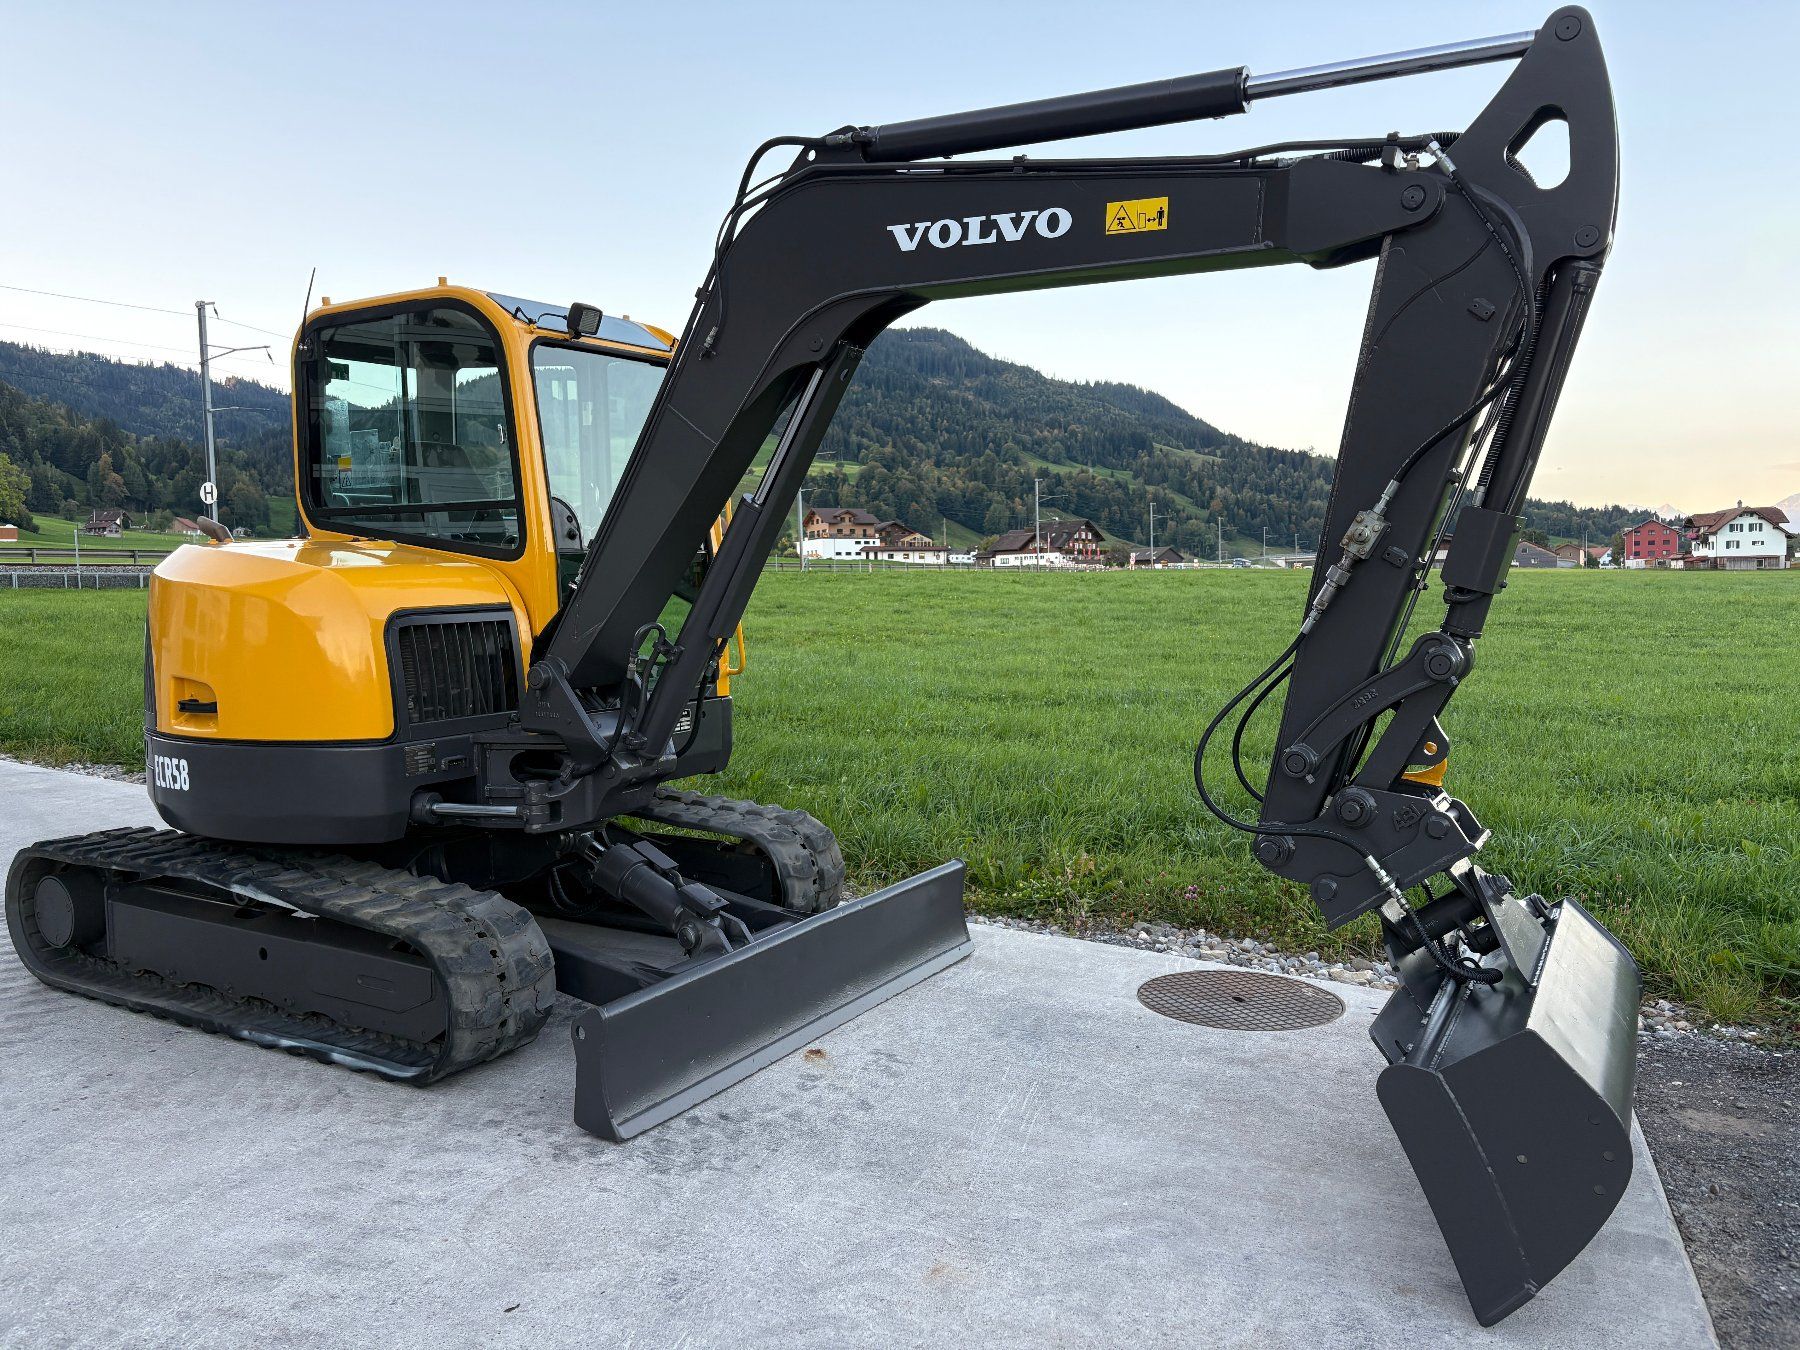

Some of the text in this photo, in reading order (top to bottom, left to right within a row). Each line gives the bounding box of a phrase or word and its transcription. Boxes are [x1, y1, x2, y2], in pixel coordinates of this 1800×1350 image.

[887, 207, 1072, 252] VOLVO
[203, 485, 214, 501] H
[154, 754, 190, 791] ECR58
